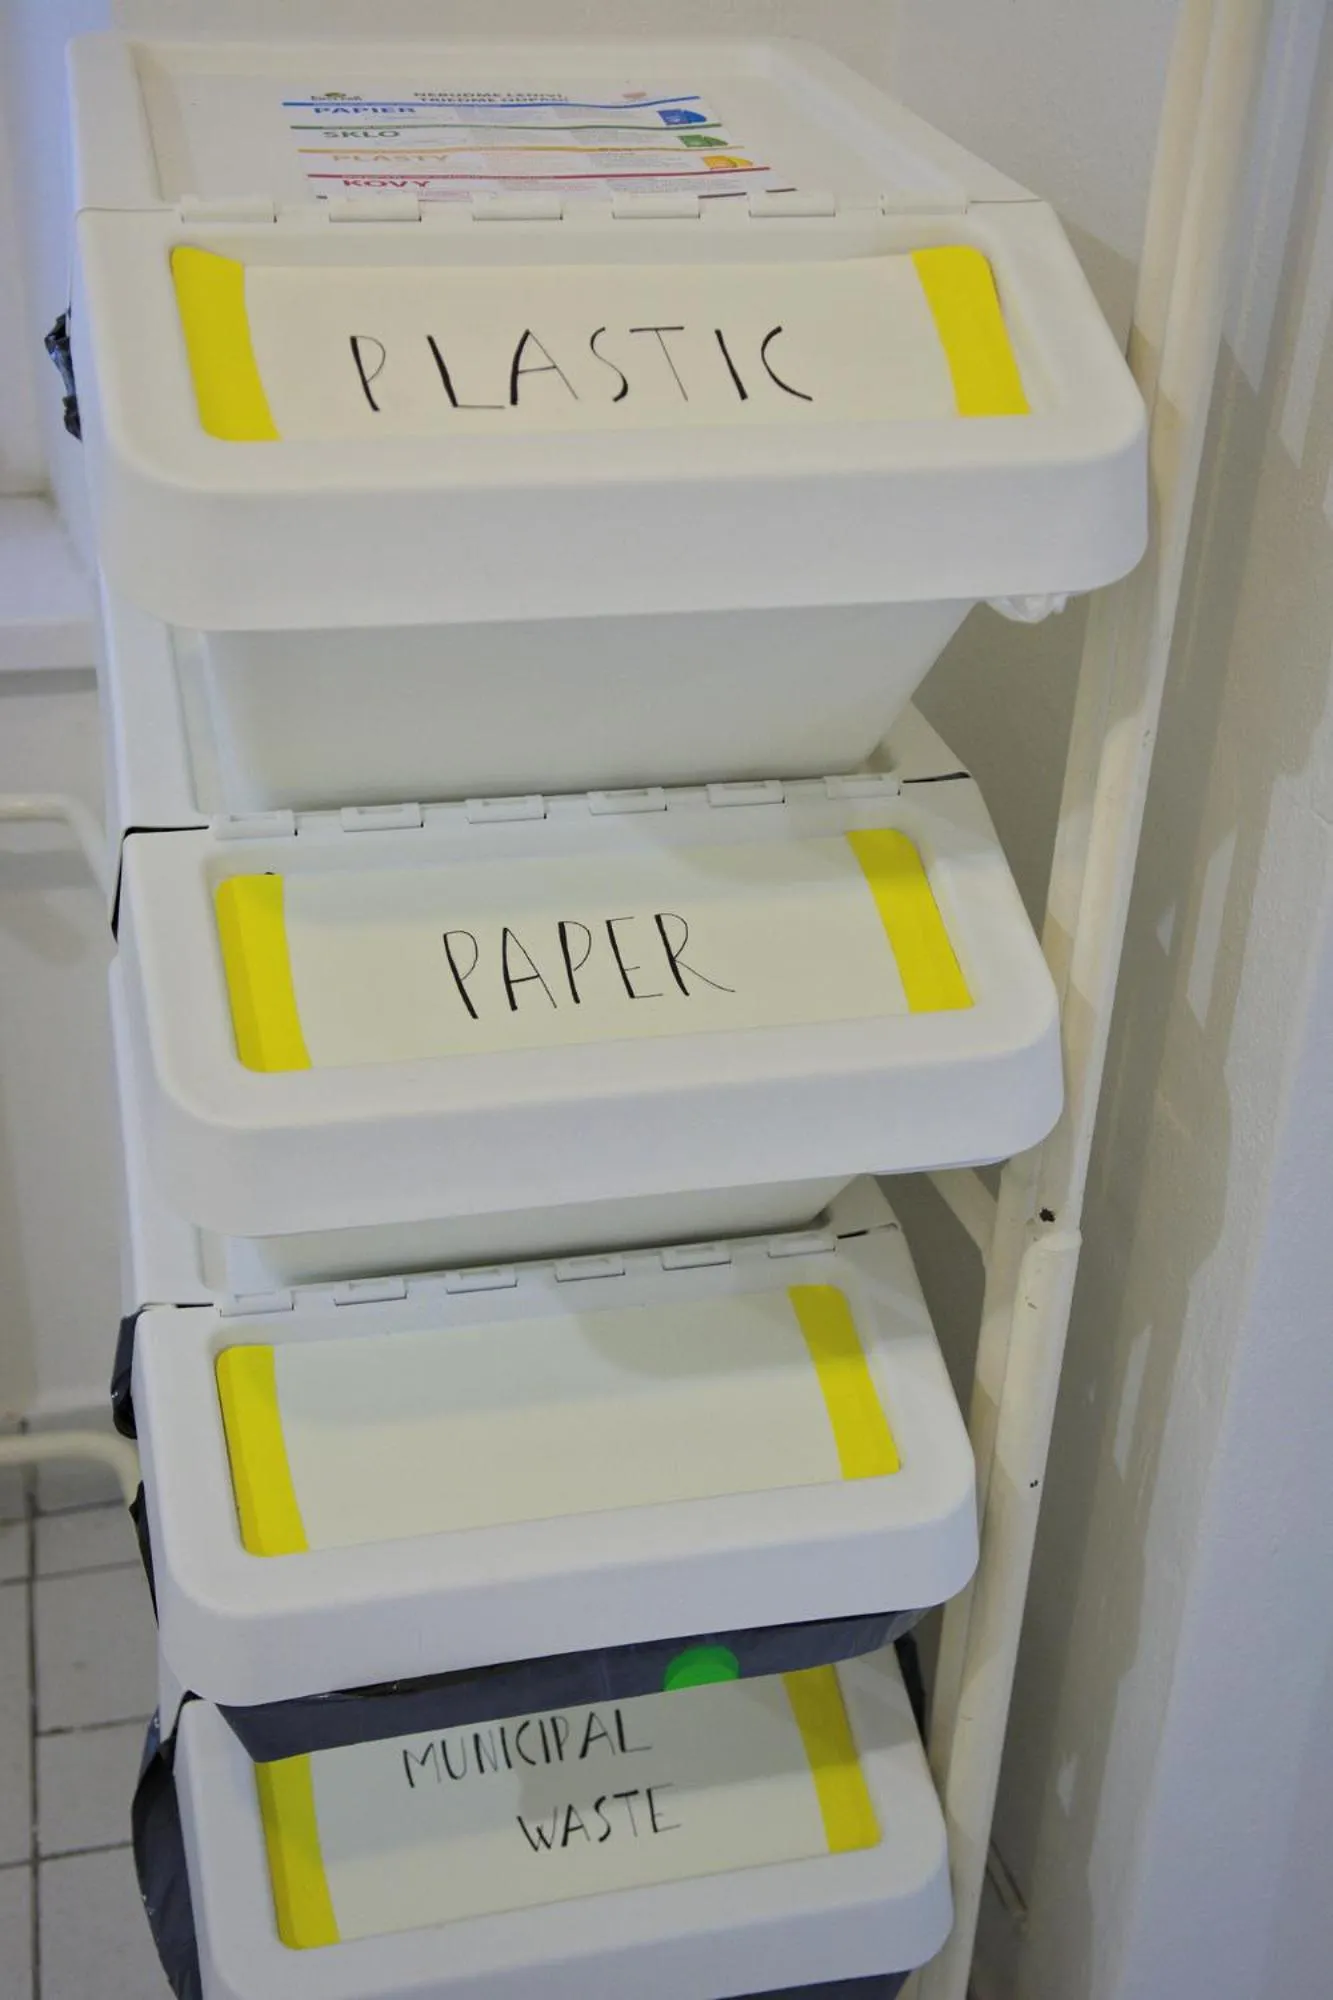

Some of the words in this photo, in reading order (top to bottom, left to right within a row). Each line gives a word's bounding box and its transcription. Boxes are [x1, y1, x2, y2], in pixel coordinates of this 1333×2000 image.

[342, 179, 431, 188] KOVY
[350, 326, 813, 412] PLASTIC
[443, 913, 736, 1019] PAPER
[403, 1708, 652, 1788] MUNICIPAL
[517, 1783, 681, 1852] WASTE
